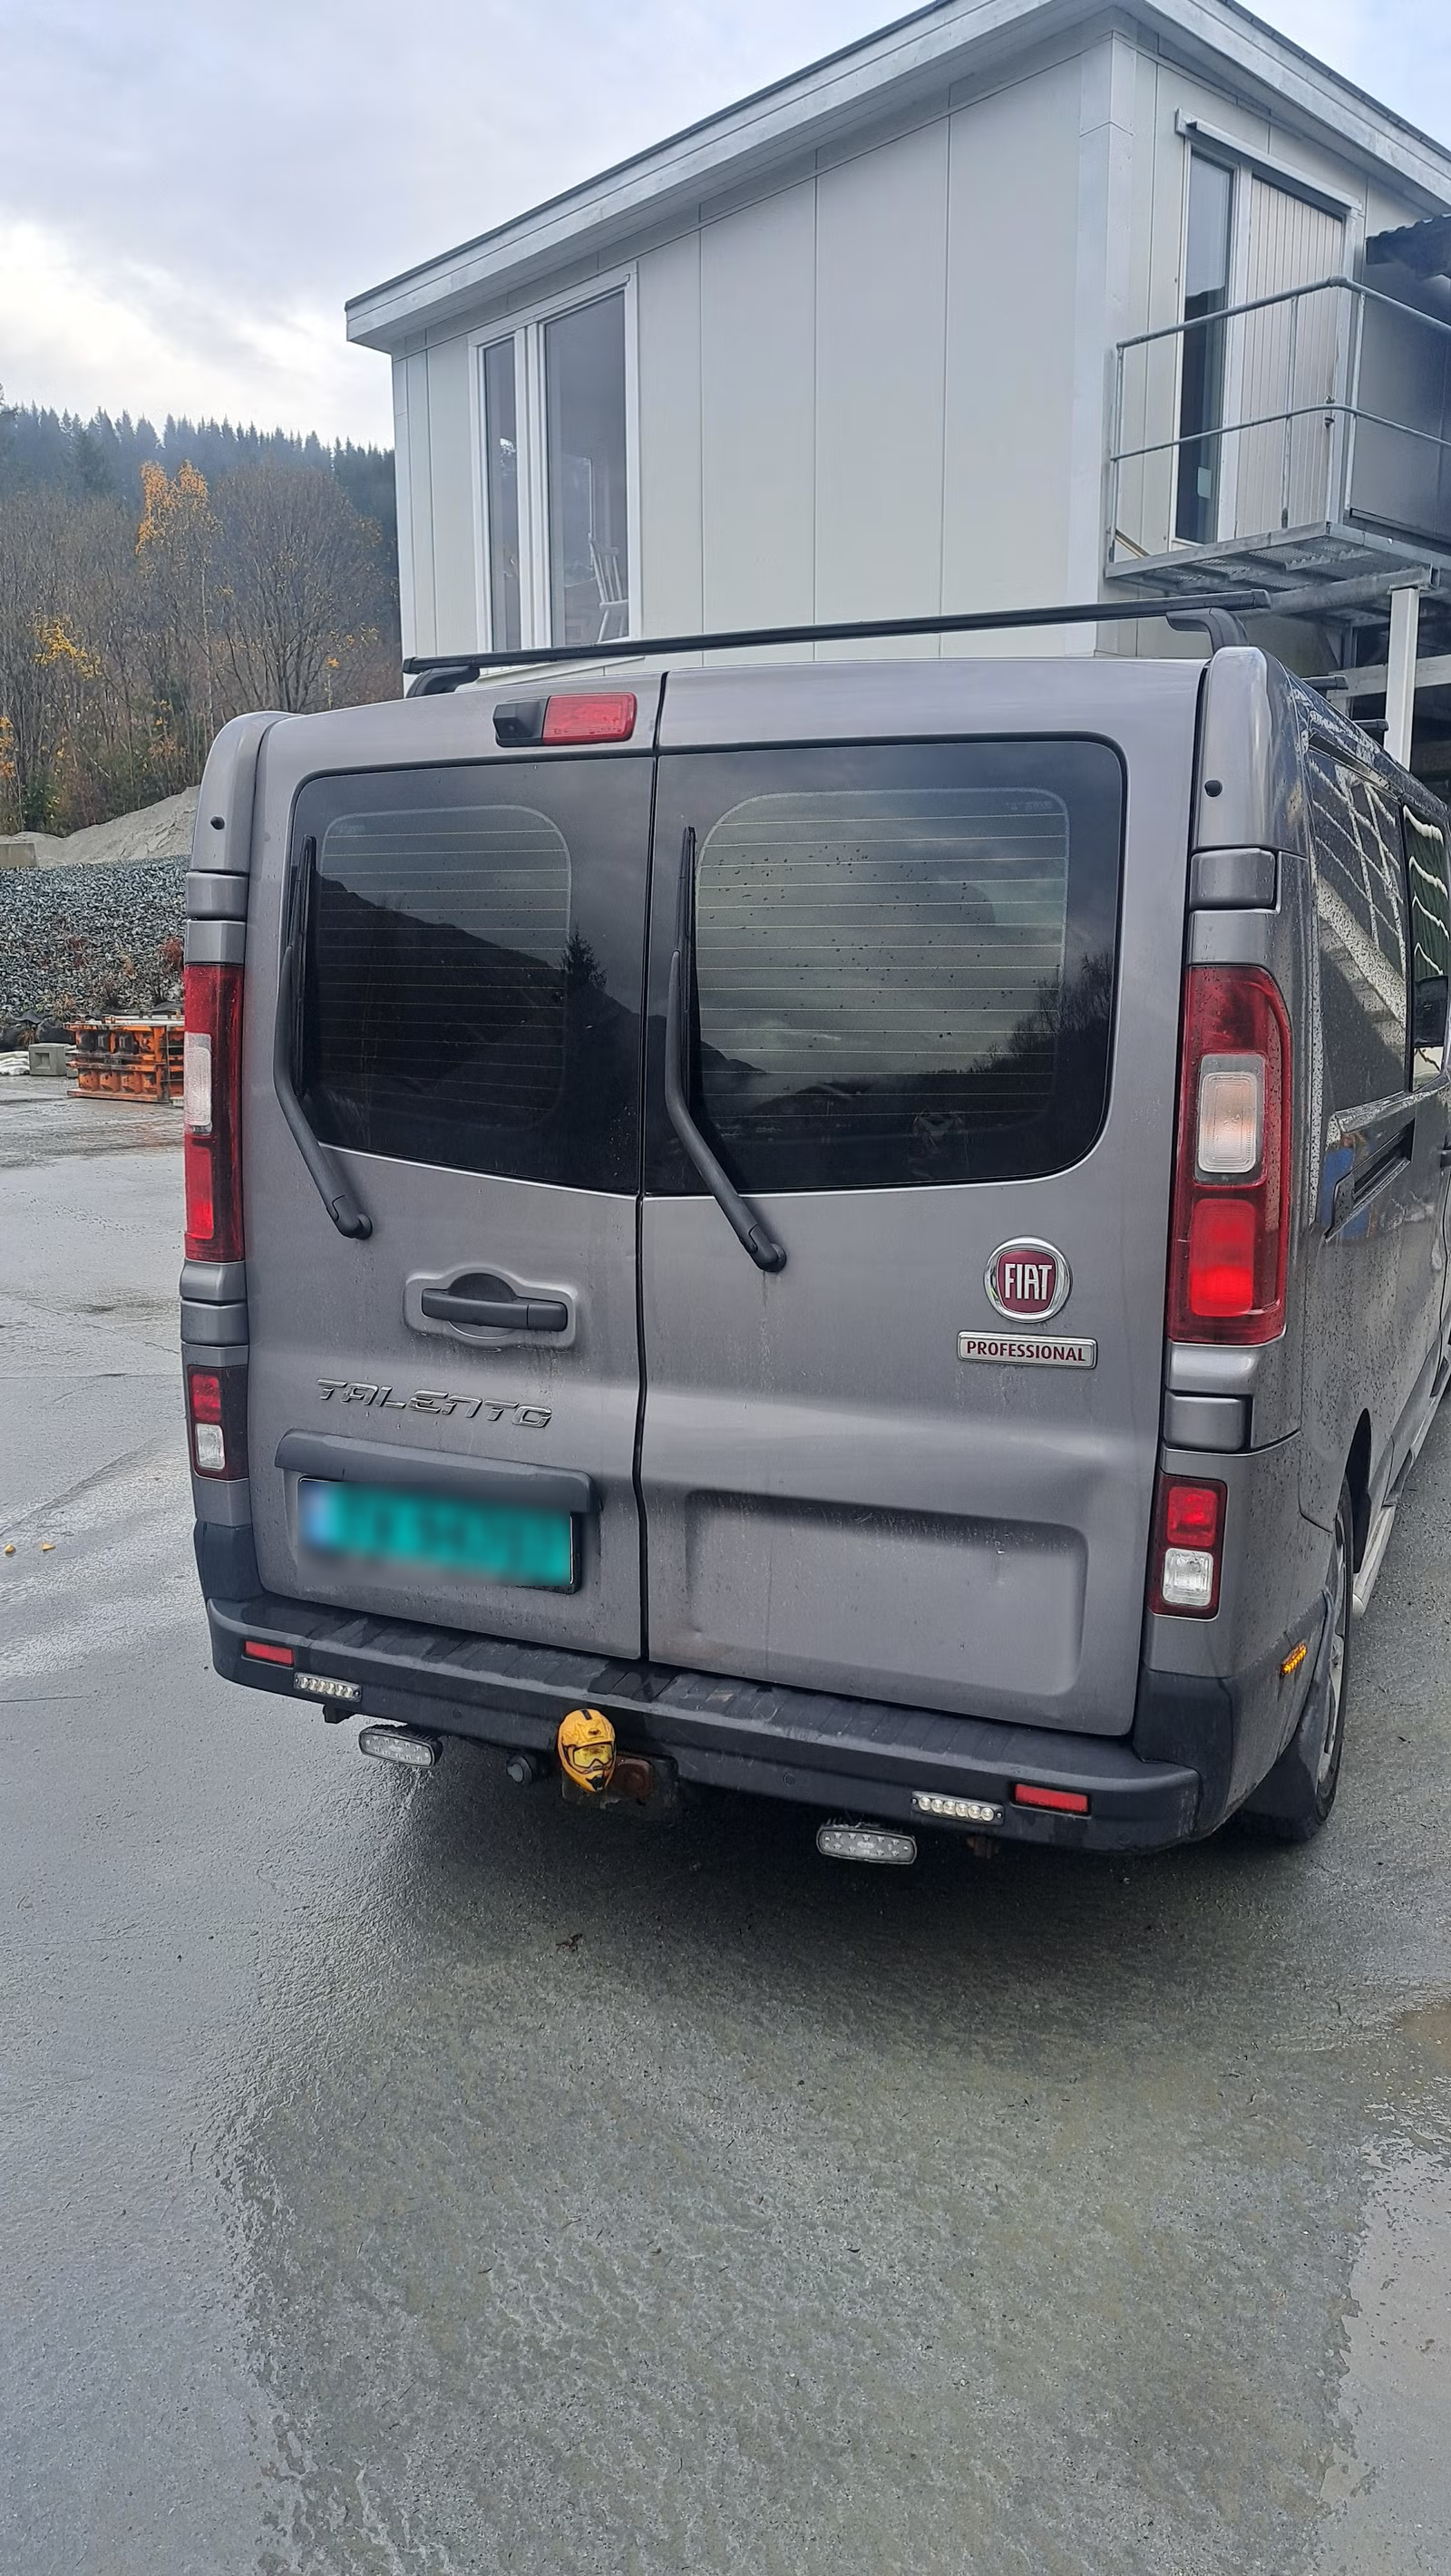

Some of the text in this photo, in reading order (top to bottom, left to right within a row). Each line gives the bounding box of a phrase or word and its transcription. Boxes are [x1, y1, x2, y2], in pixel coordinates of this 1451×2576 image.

[1004, 1263, 1052, 1300] FIAT
[967, 1340, 1086, 1362] PROFESSIONAL
[317, 1378, 552, 1428] TALENTO
